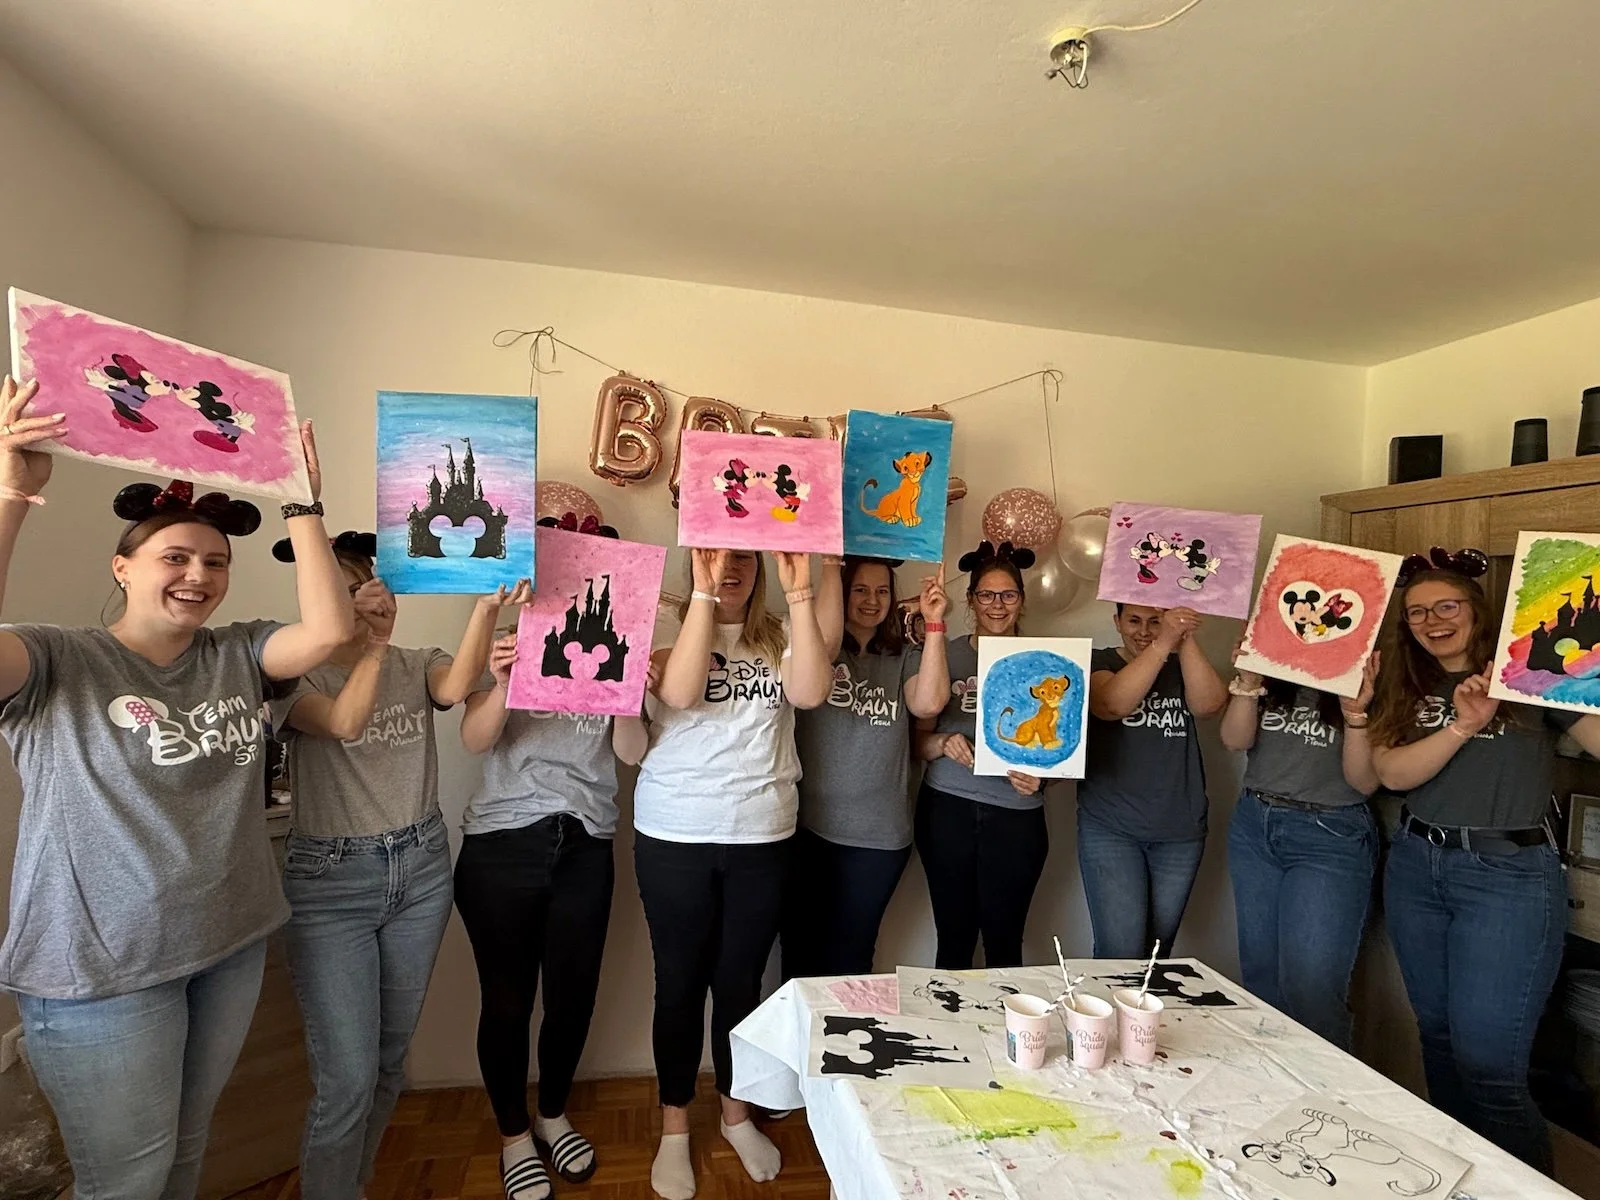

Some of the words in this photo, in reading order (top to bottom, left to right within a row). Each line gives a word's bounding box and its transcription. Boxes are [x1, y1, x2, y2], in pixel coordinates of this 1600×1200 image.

[827, 679, 898, 721] BRAUT
[854, 679, 885, 698] TEAM
[1147, 691, 1182, 711] TEAM
[177, 695, 248, 733] TEAM
[368, 703, 406, 726] EAM
